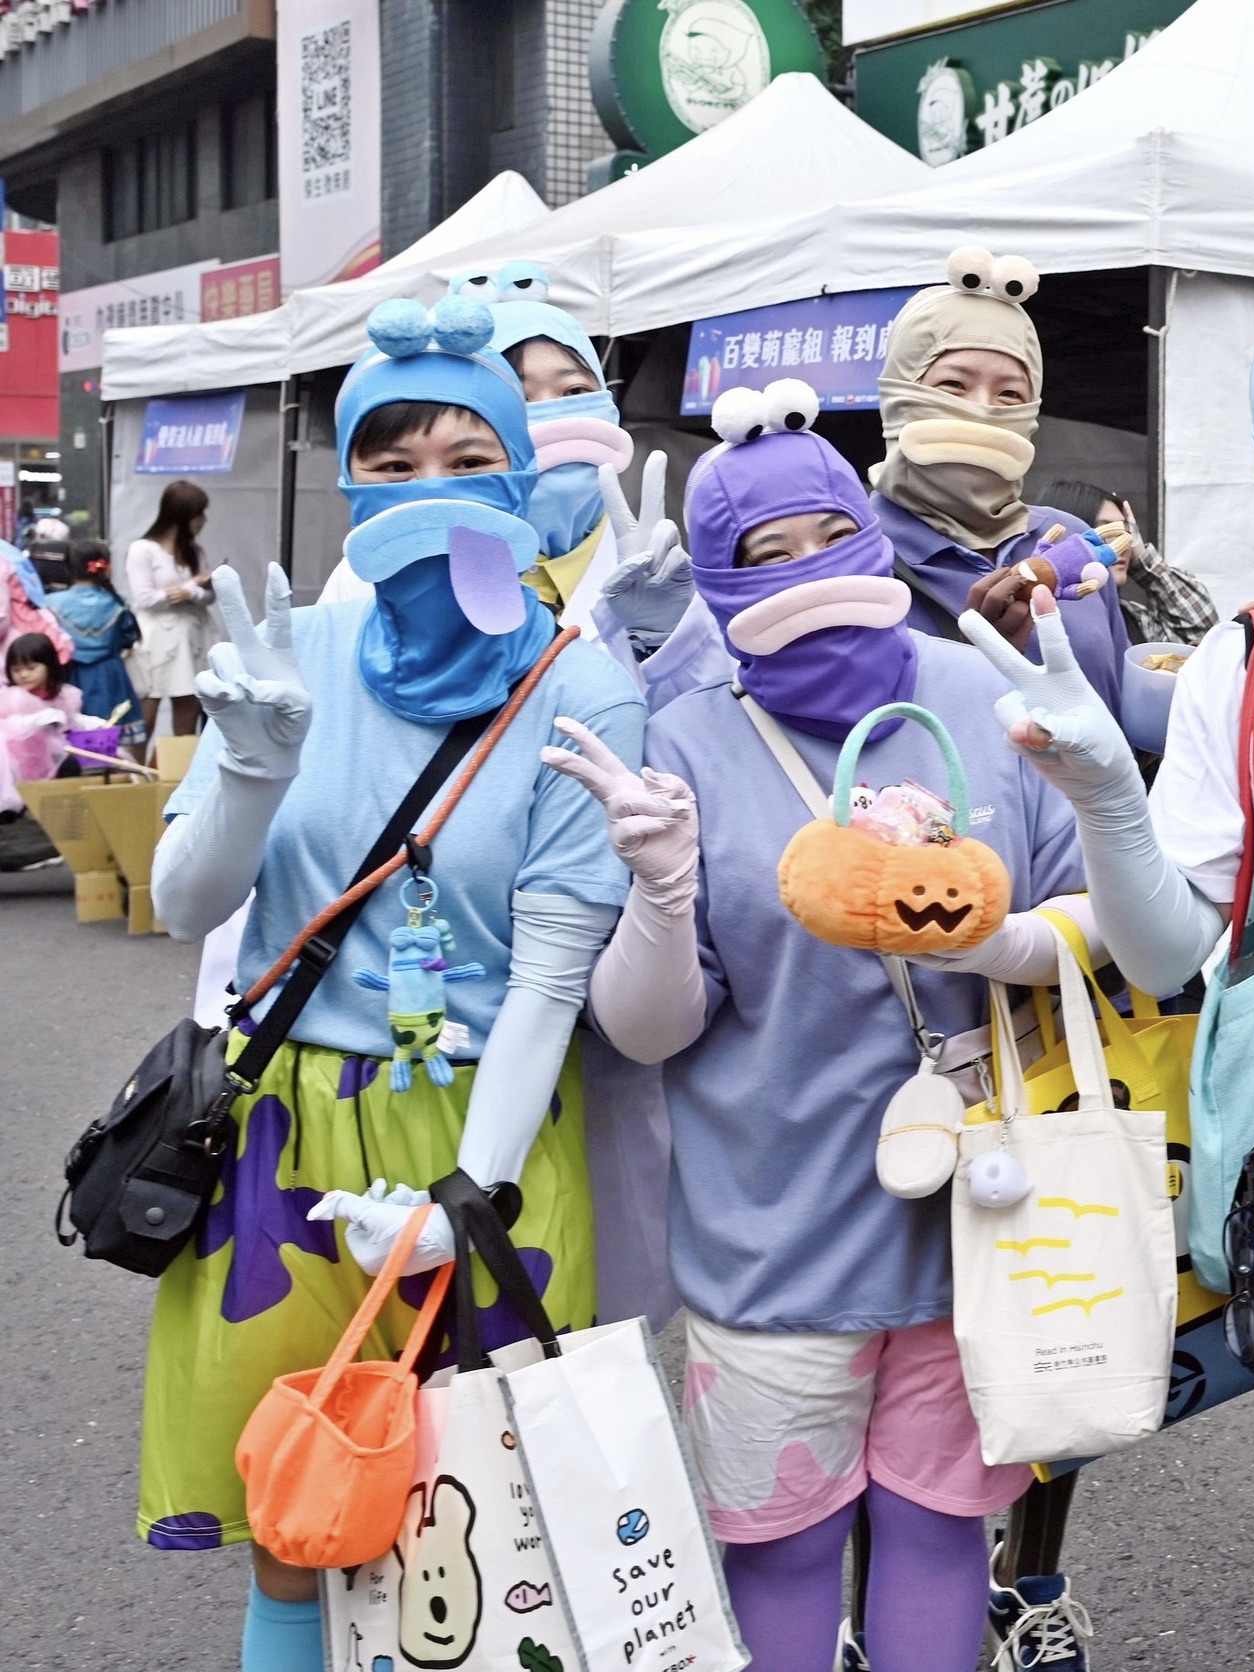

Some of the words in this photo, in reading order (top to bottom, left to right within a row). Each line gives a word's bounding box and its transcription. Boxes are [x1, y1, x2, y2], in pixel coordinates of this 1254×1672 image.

[723, 327, 823, 369] 百變萌寵組
[1035, 1347, 1057, 1356] Read
[632, 1582, 674, 1615] our
[624, 1600, 696, 1664] planet
